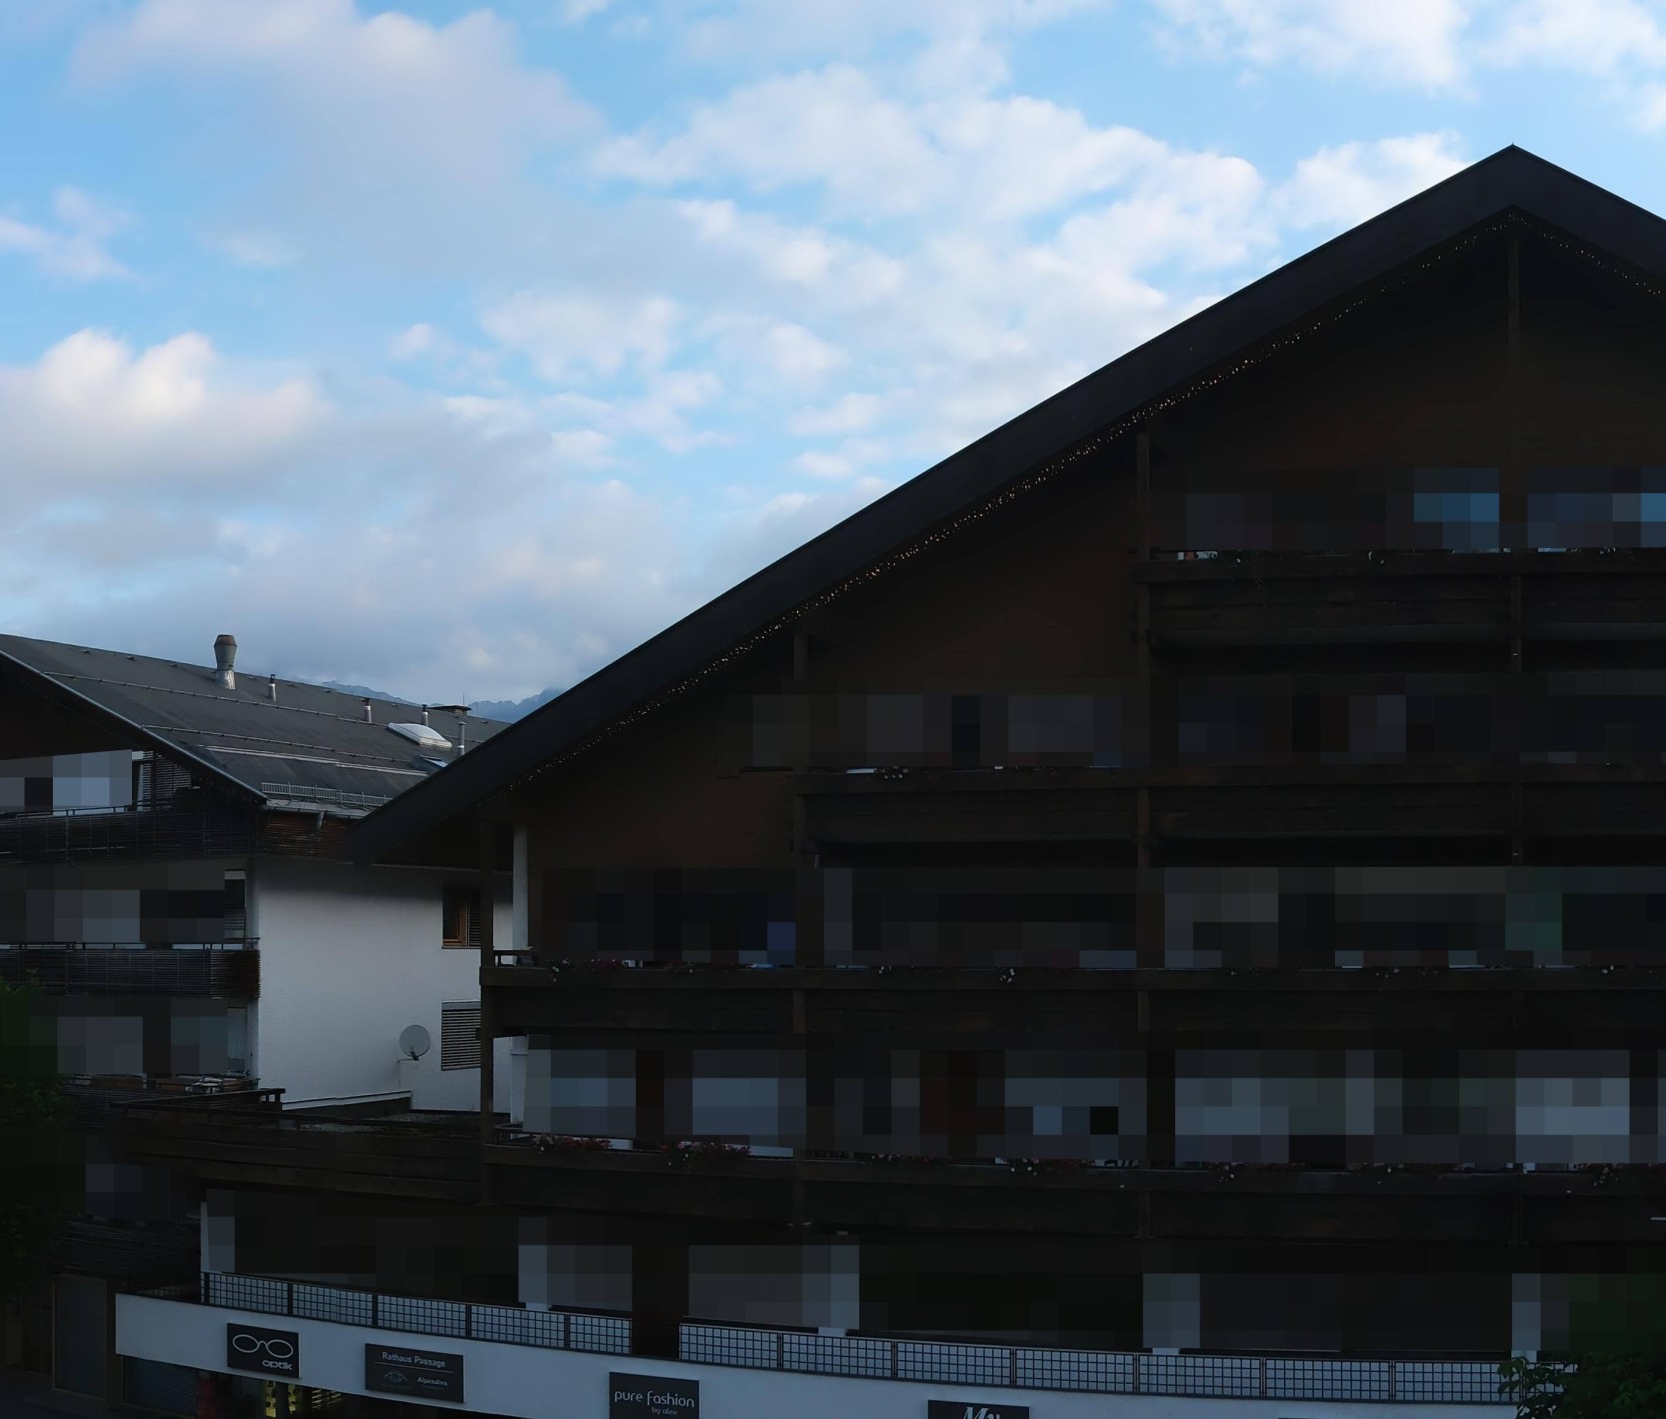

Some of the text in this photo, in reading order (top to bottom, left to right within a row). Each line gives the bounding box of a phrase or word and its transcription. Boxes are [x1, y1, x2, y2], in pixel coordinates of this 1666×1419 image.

[262, 1359, 294, 1371] optik
[382, 1352, 446, 1368] Rathaus Passage
[614, 1390, 694, 1408] pure fashion
